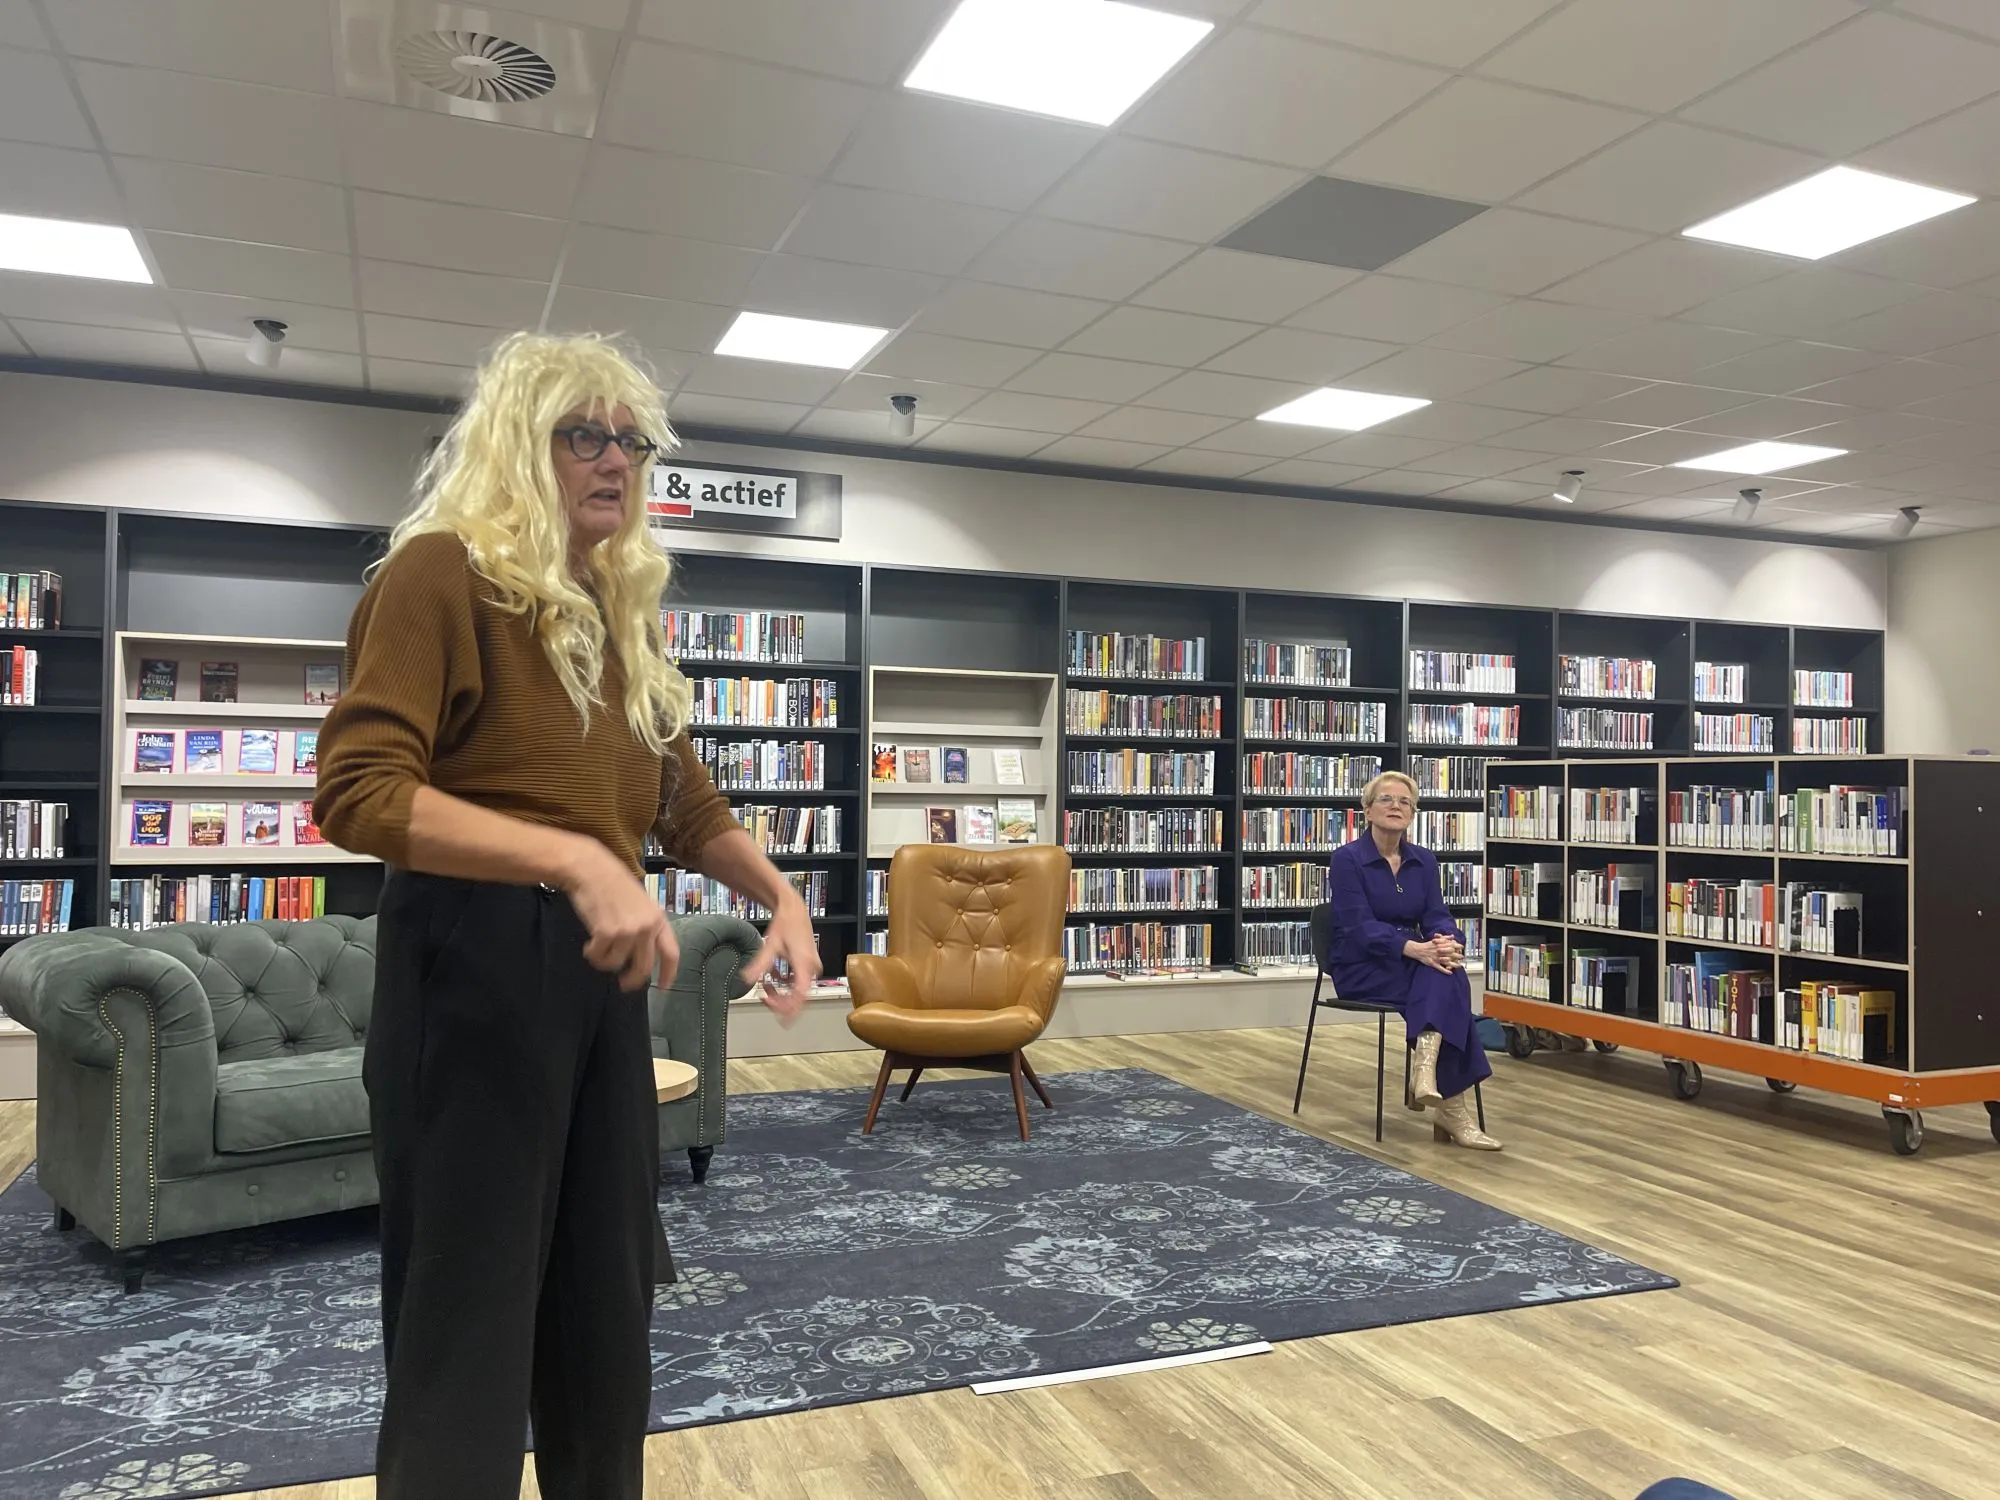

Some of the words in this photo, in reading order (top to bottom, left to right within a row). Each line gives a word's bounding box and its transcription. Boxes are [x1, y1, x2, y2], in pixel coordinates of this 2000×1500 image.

[666, 472, 691, 500] &
[701, 480, 787, 508] actief
[788, 699, 798, 720] BOX
[137, 739, 174, 747] Grisham
[142, 734, 163, 743] John
